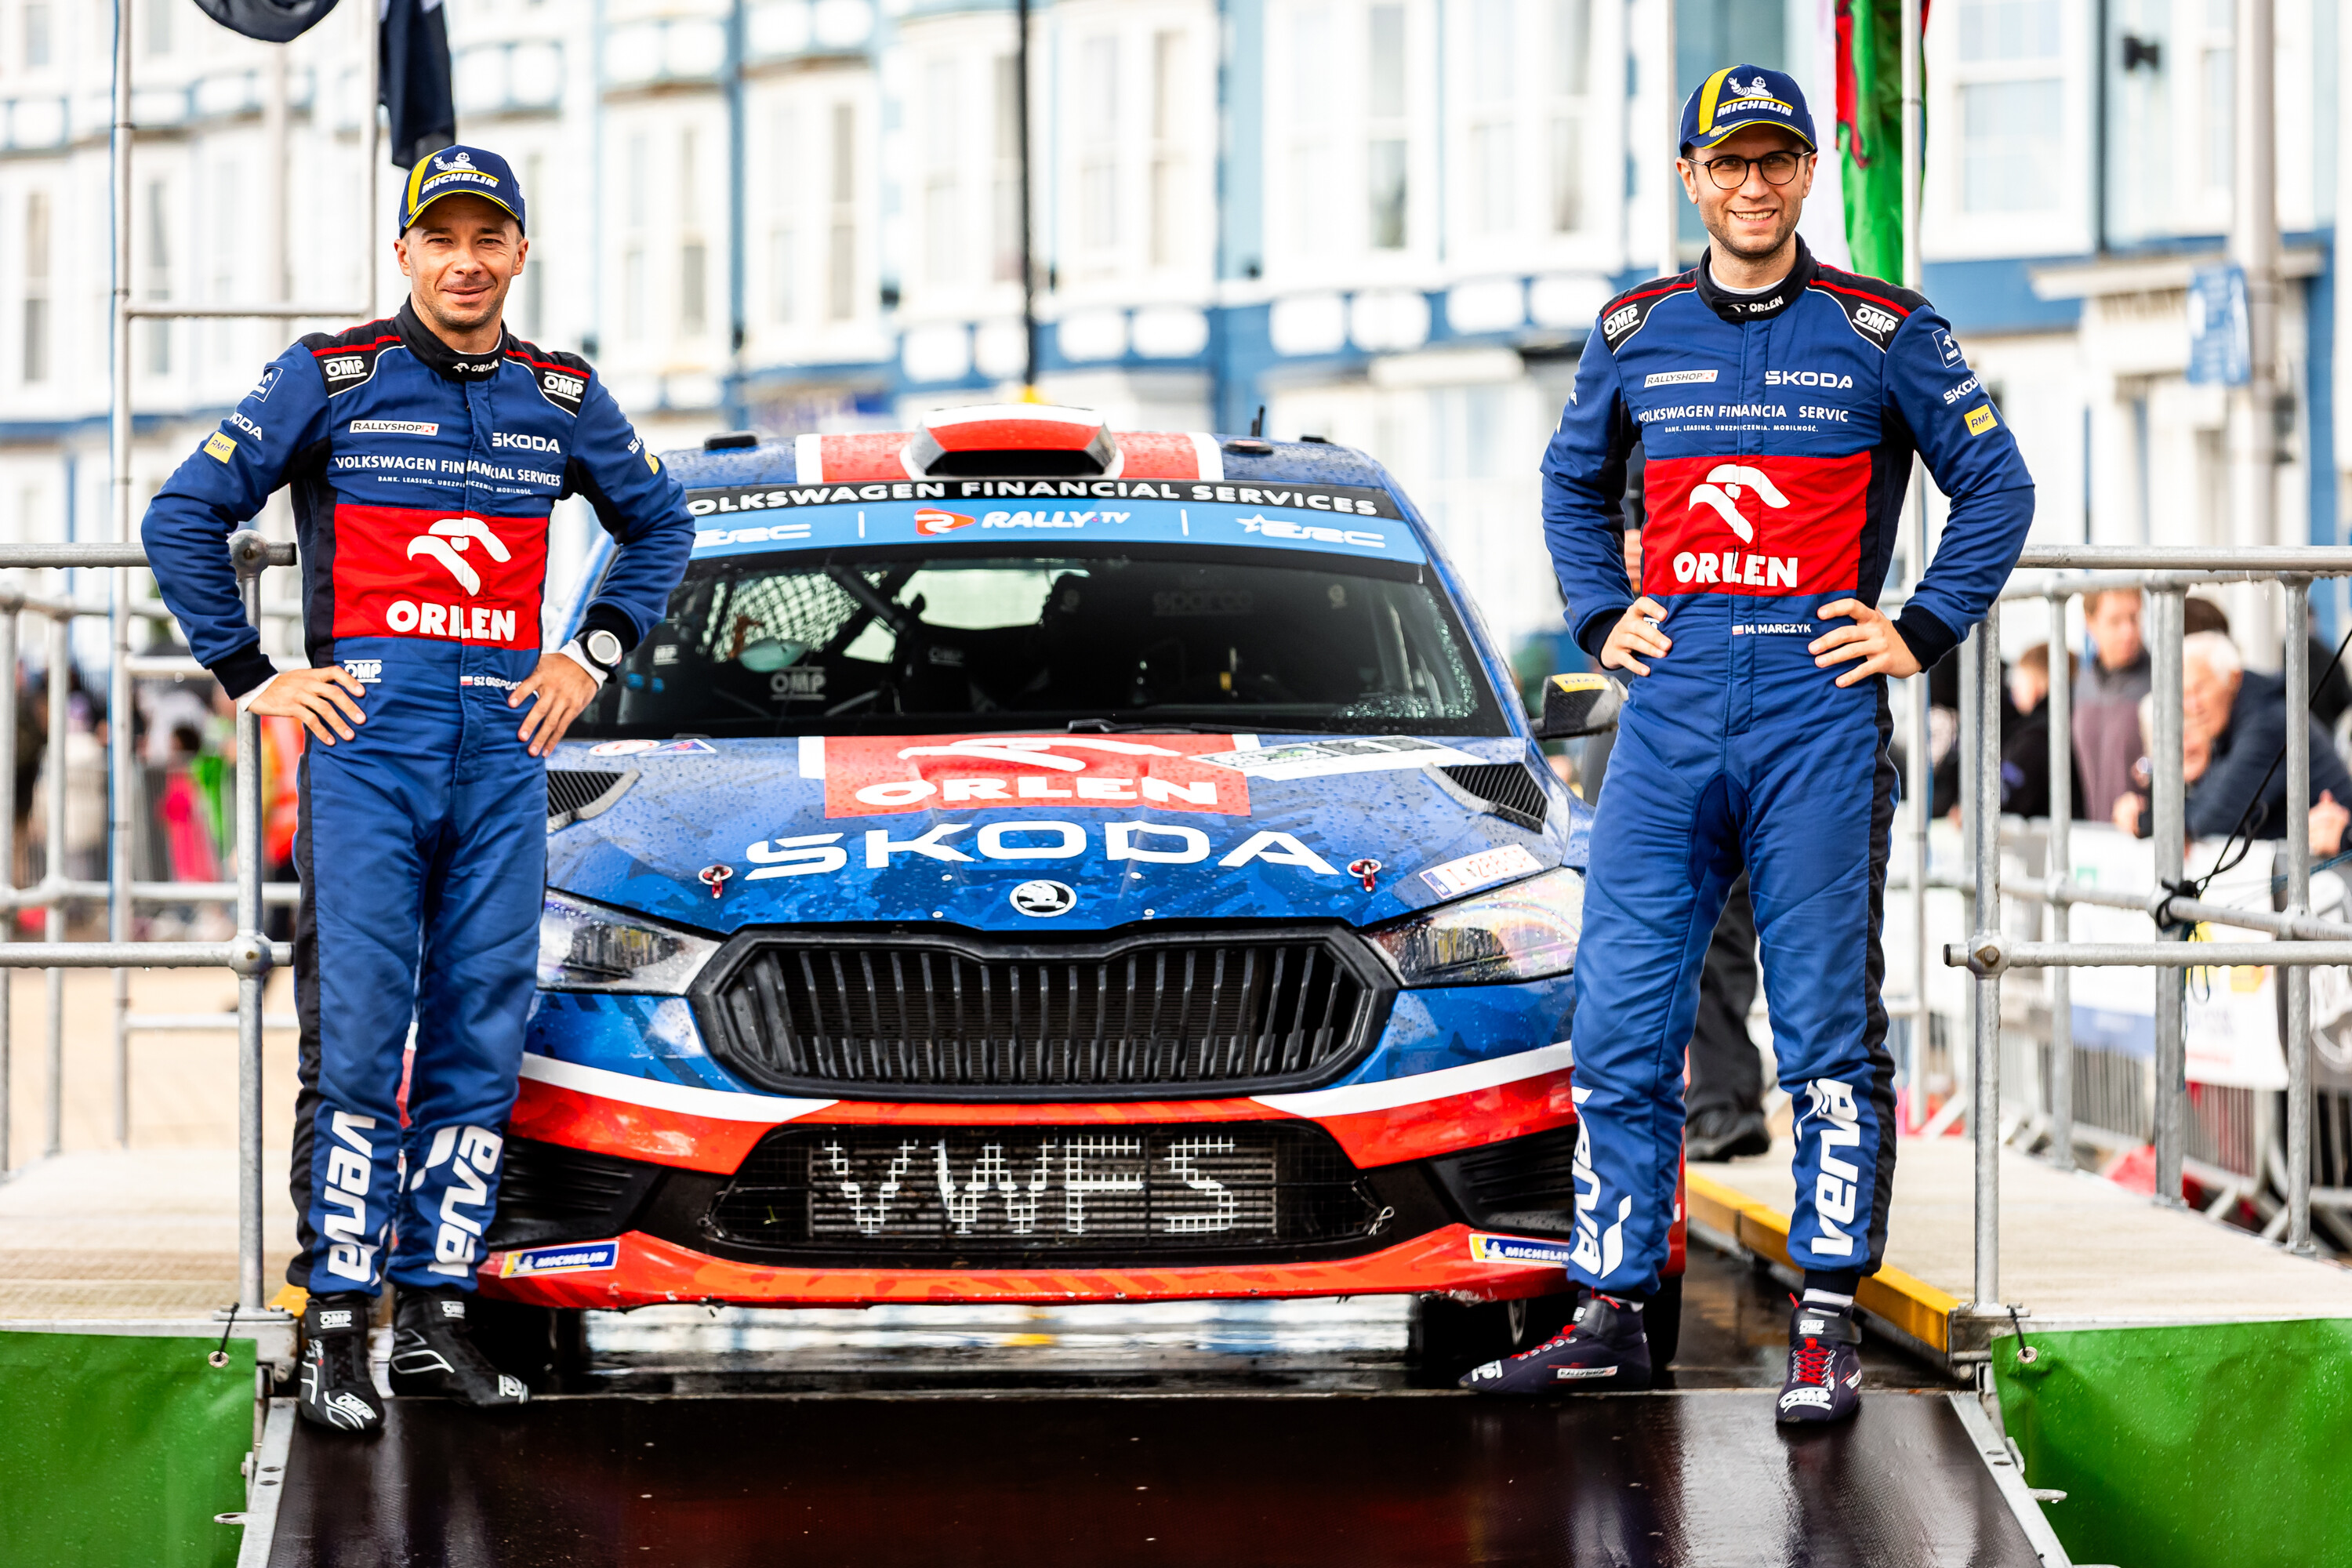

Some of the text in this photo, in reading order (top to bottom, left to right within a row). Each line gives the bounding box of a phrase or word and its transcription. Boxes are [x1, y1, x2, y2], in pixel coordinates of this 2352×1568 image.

[1717, 100, 1792, 118] MICHELIN
[422, 172, 498, 194] MICHELIN
[1748, 296, 1784, 313] ORLEN
[1604, 307, 1639, 336] OMP
[1856, 304, 1896, 333] OMP
[325, 358, 365, 378] OMP
[543, 375, 583, 397] OMP
[1639, 405, 1714, 422] VOLKSWAGEN
[1971, 412, 1990, 428] RMF
[210, 439, 230, 452] RMF
[336, 456, 436, 471] VOLKSWAGEN
[517, 469, 561, 488] SERVICES
[403, 477, 435, 485] LEASING.
[687, 481, 1377, 516] OLKSWAGEN FINANCIAL SERVICES
[1672, 551, 1798, 588] ORLEN
[386, 600, 516, 641] ORLEN
[1745, 623, 1812, 634] M. MARCZYK
[344, 662, 382, 679] OMP
[770, 670, 827, 695] OMP
[855, 776, 1218, 805] ORLEN
[1810, 1078, 1860, 1256] verva
[823, 1137, 1237, 1235] VWFS
[535, 1251, 608, 1268] MICHELIN
[1504, 1246, 1569, 1262] MICHELIN
[320, 1313, 352, 1326] OMP
